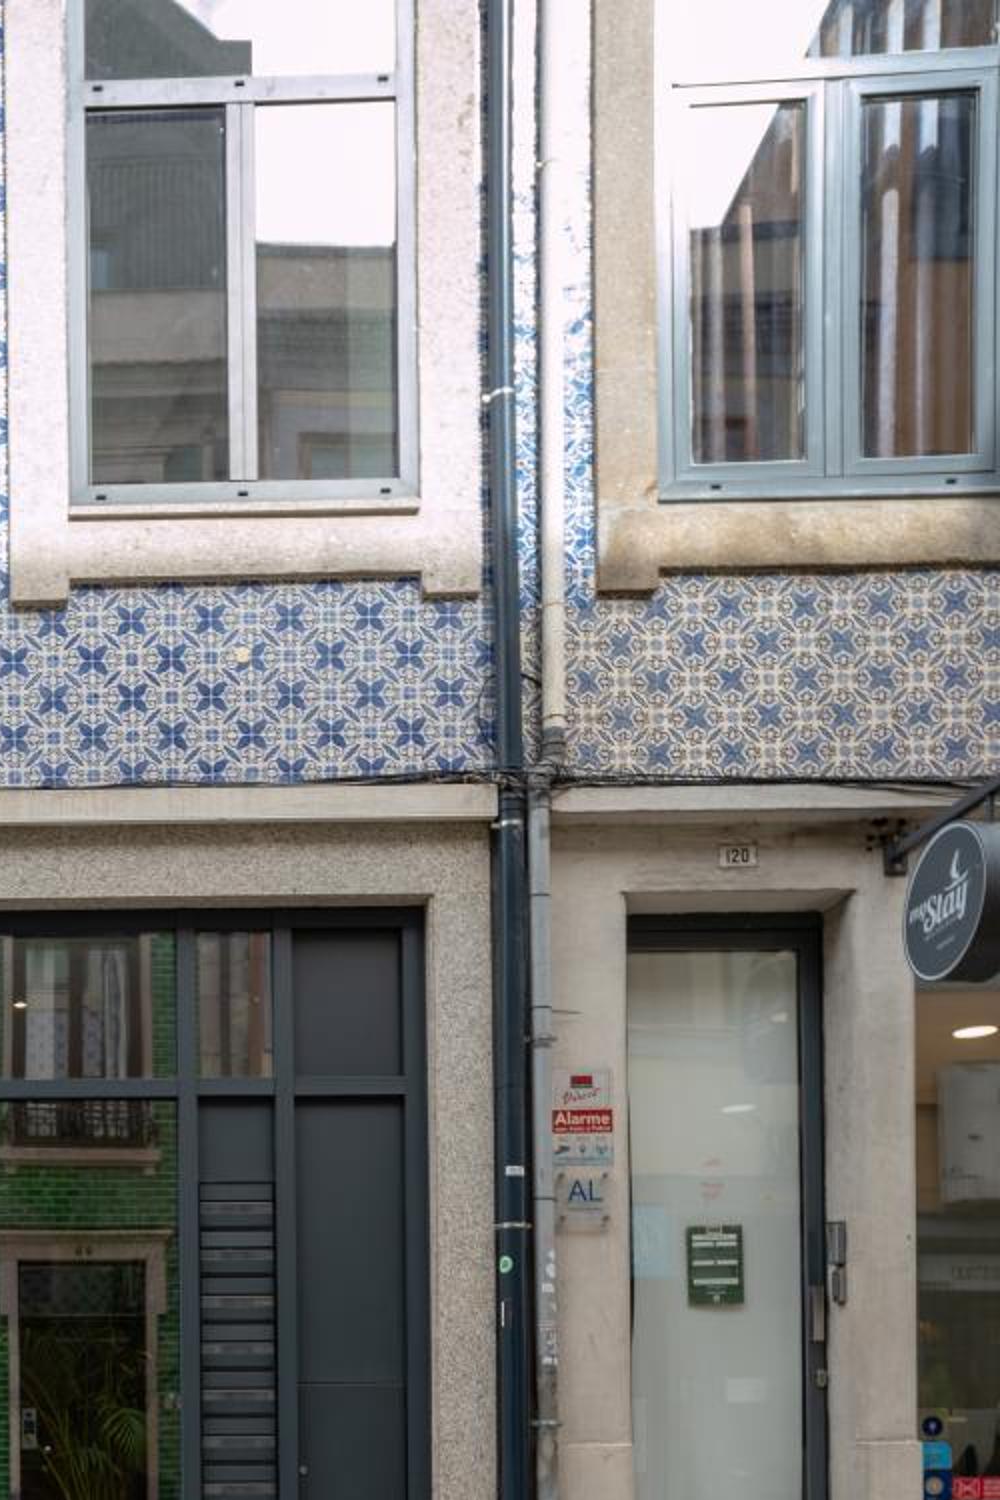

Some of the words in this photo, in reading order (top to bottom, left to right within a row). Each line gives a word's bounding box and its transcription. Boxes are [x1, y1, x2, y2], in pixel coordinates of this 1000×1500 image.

[725, 847, 750, 864] 120
[554, 1111, 612, 1127] Alarme
[568, 1179, 604, 1202] AL
